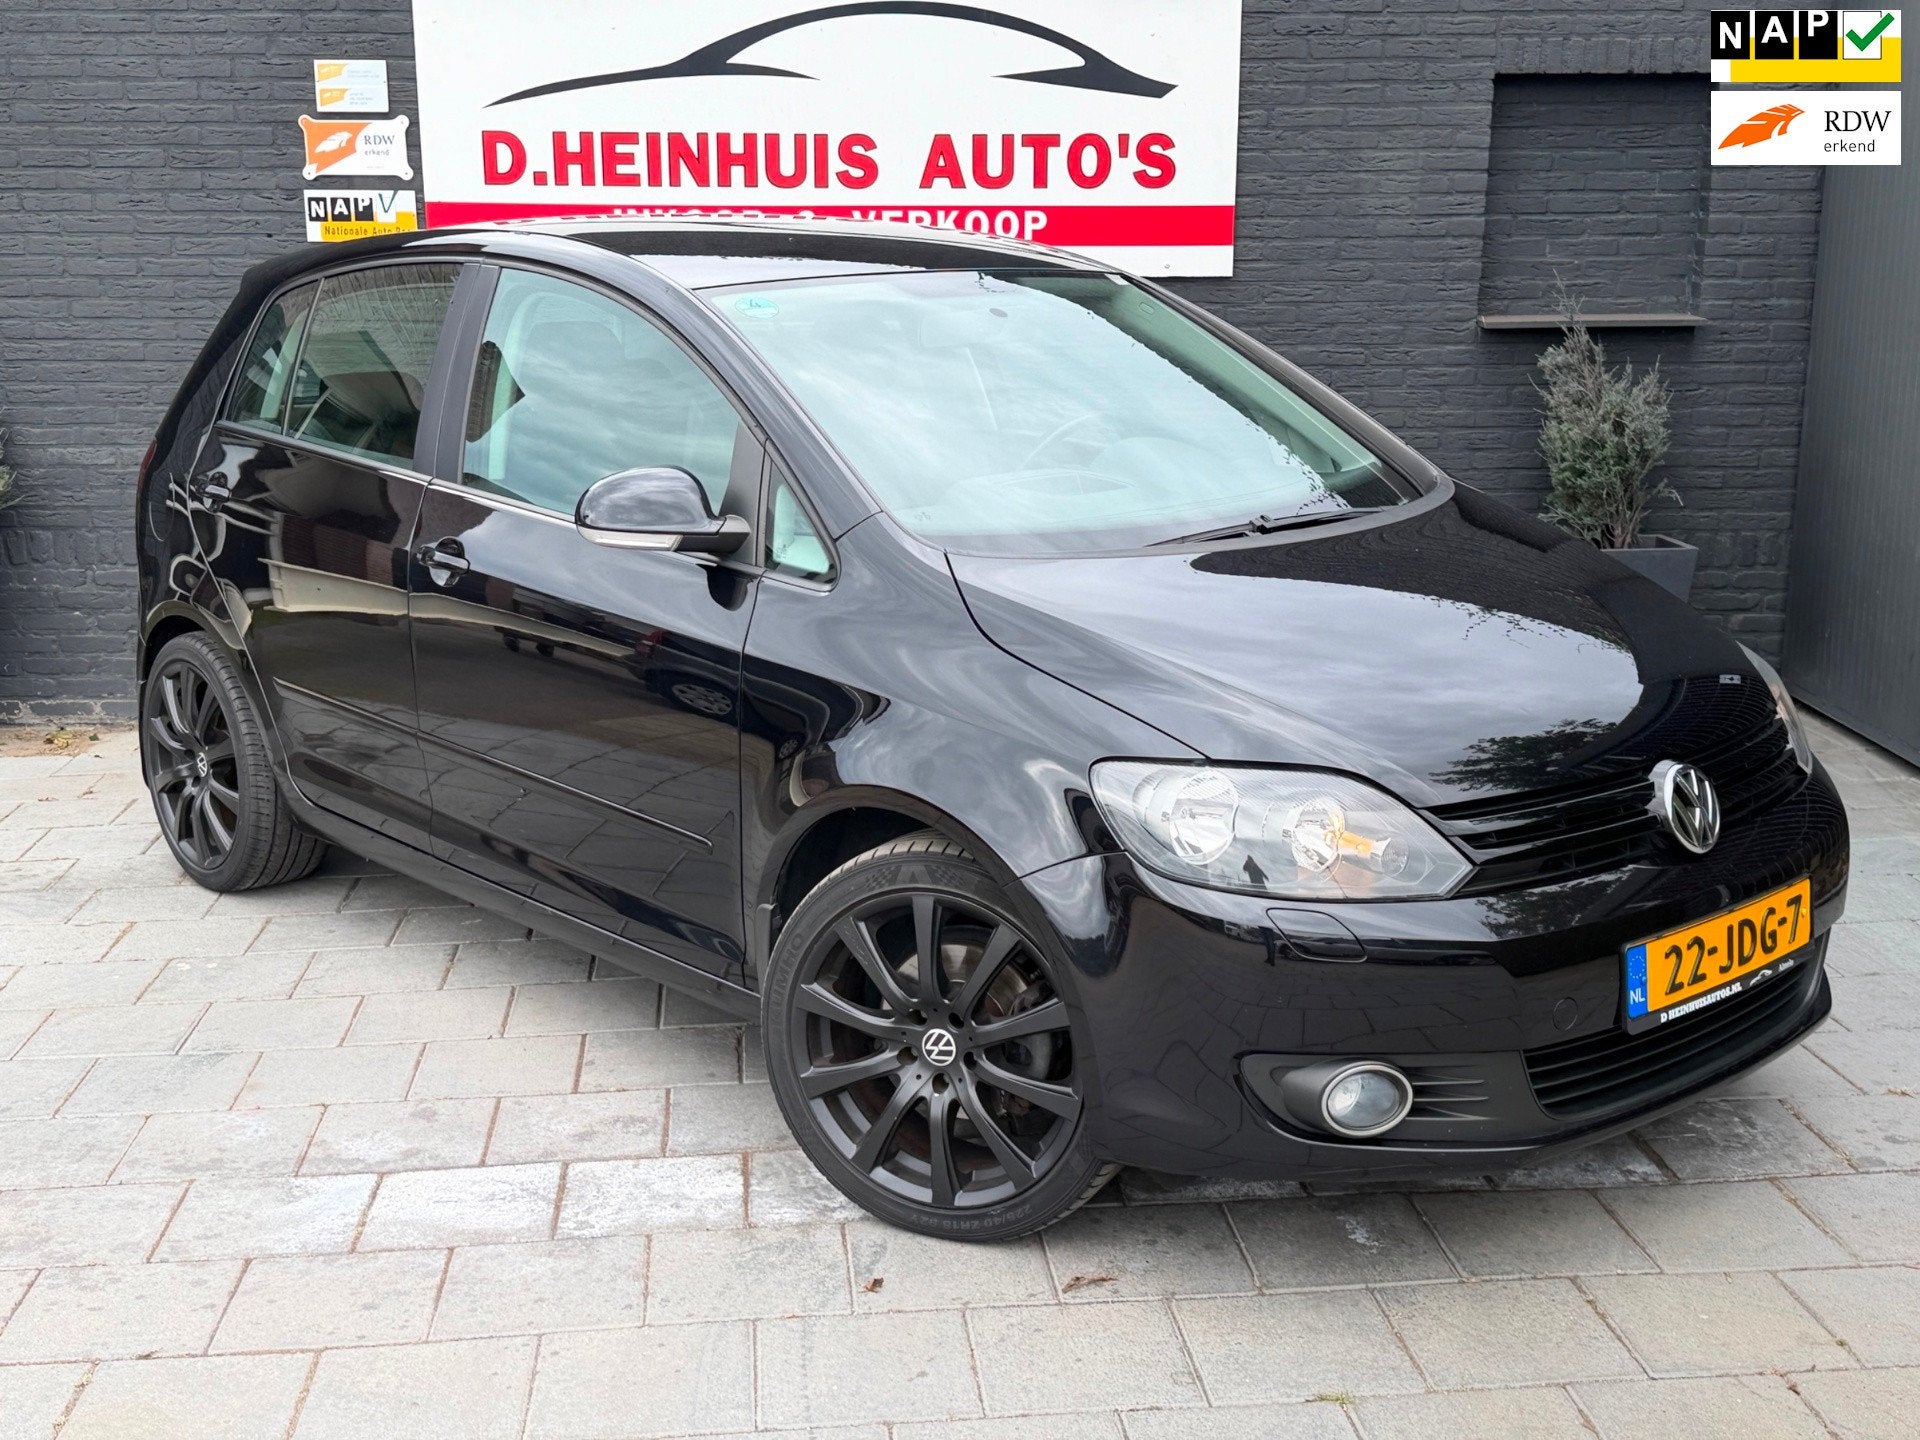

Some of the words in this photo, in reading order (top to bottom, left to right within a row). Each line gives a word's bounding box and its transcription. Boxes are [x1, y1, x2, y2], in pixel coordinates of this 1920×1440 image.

[363, 134, 395, 146] RDW
[364, 148, 390, 156] erkend
[481, 130, 879, 189] D.HEINHUIS
[918, 132, 1177, 189] AUTO'S
[311, 197, 371, 218] NAP
[324, 225, 368, 236] Nationale
[1664, 894, 1803, 996] 22-JDG-7
[1629, 987, 1646, 1005] NL
